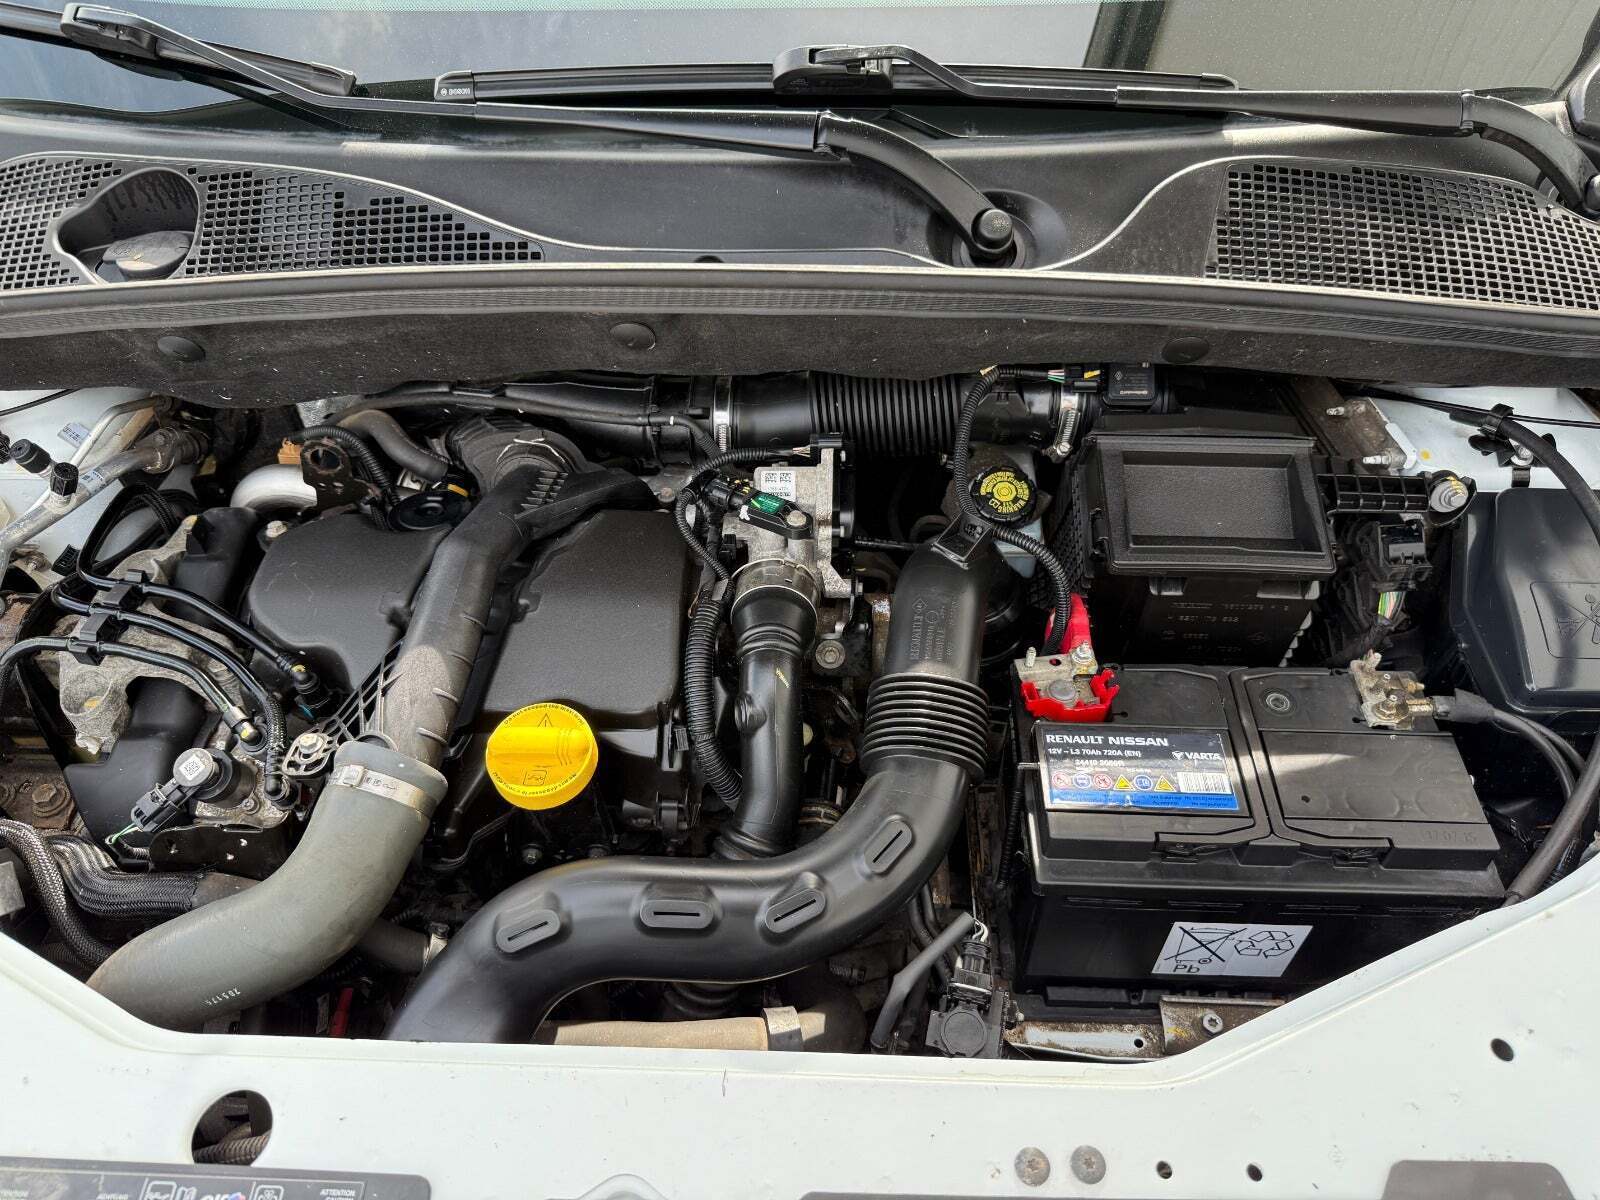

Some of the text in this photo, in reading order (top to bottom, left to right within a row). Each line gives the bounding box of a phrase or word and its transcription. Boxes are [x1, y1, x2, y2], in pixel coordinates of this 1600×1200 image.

[448, 88, 471, 96] BOSCH
[997, 499, 1027, 514] WARNING
[1046, 734, 1169, 747] RENAULT NISSAN
[1182, 751, 1223, 761] VARTA
[1172, 964, 1201, 974] Pb
[320, 1188, 356, 1197] ATTENTION
